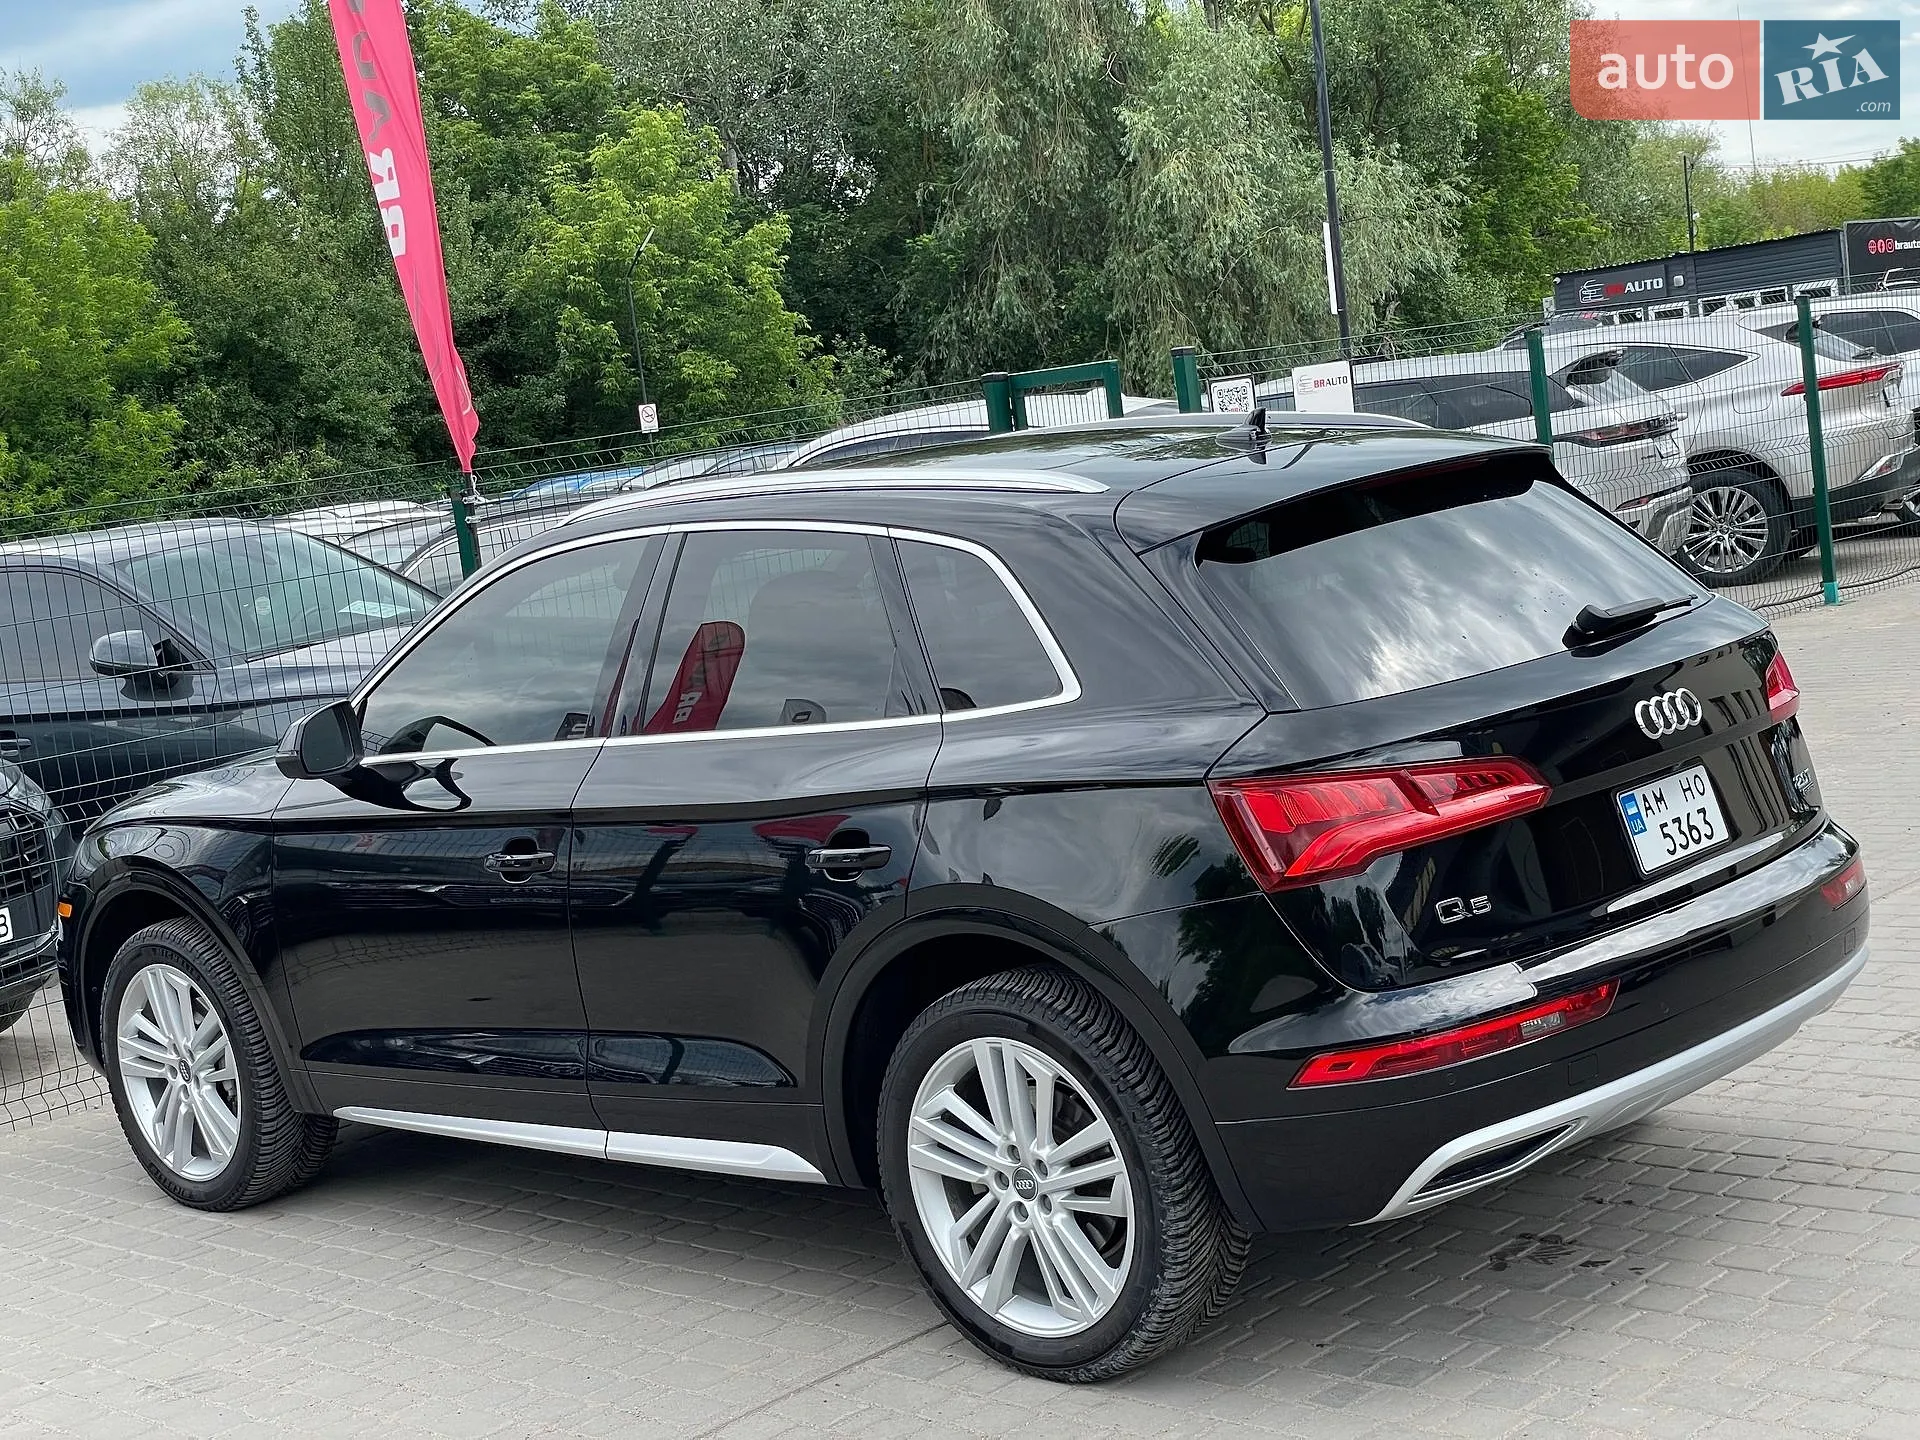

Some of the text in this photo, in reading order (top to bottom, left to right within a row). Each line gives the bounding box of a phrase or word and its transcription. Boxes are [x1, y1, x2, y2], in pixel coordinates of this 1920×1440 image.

[1313, 375, 1348, 389] BRAUTO
[1641, 774, 1706, 818] AM HO
[1630, 818, 1645, 833] UA
[1659, 807, 1714, 856] 5363
[1435, 895, 1492, 924] Q5
